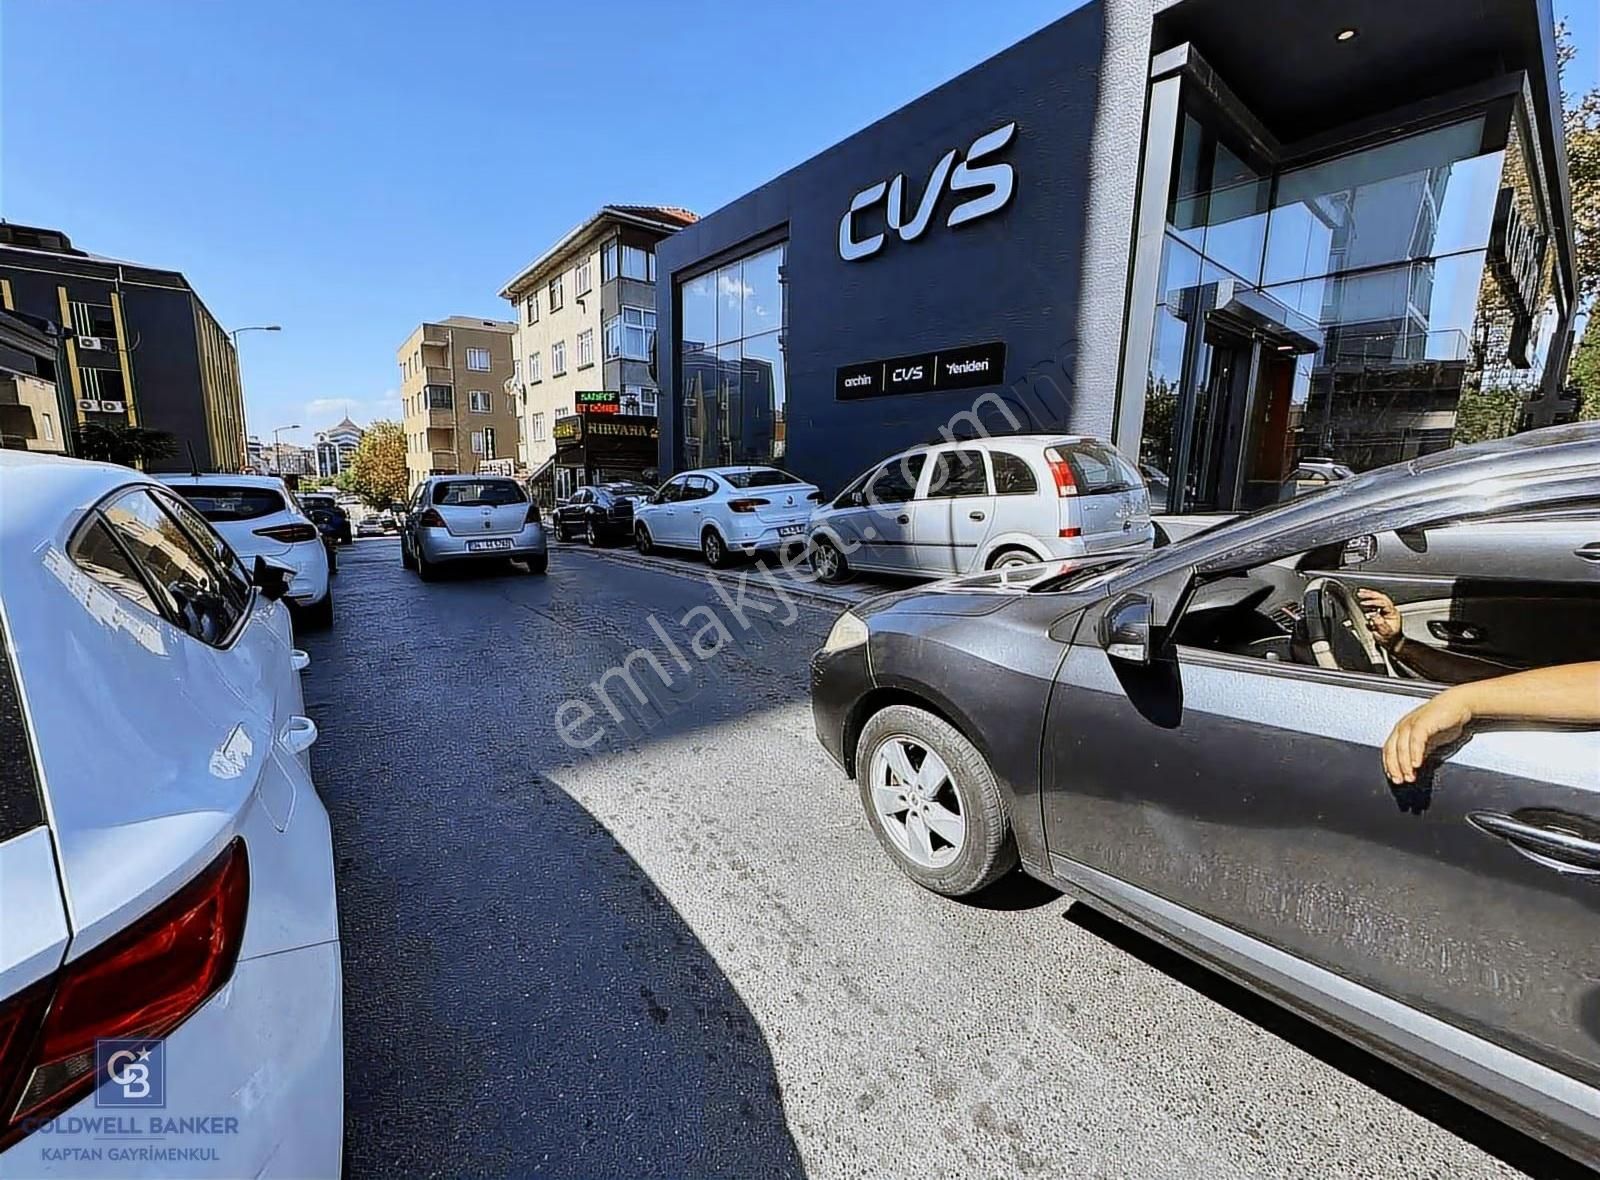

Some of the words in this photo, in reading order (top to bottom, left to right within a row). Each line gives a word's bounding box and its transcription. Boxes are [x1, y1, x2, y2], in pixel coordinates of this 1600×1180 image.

[839, 121, 1015, 261] CVS
[844, 374, 872, 387] archin
[892, 365, 923, 382] CVS
[946, 358, 989, 375] Yeniden
